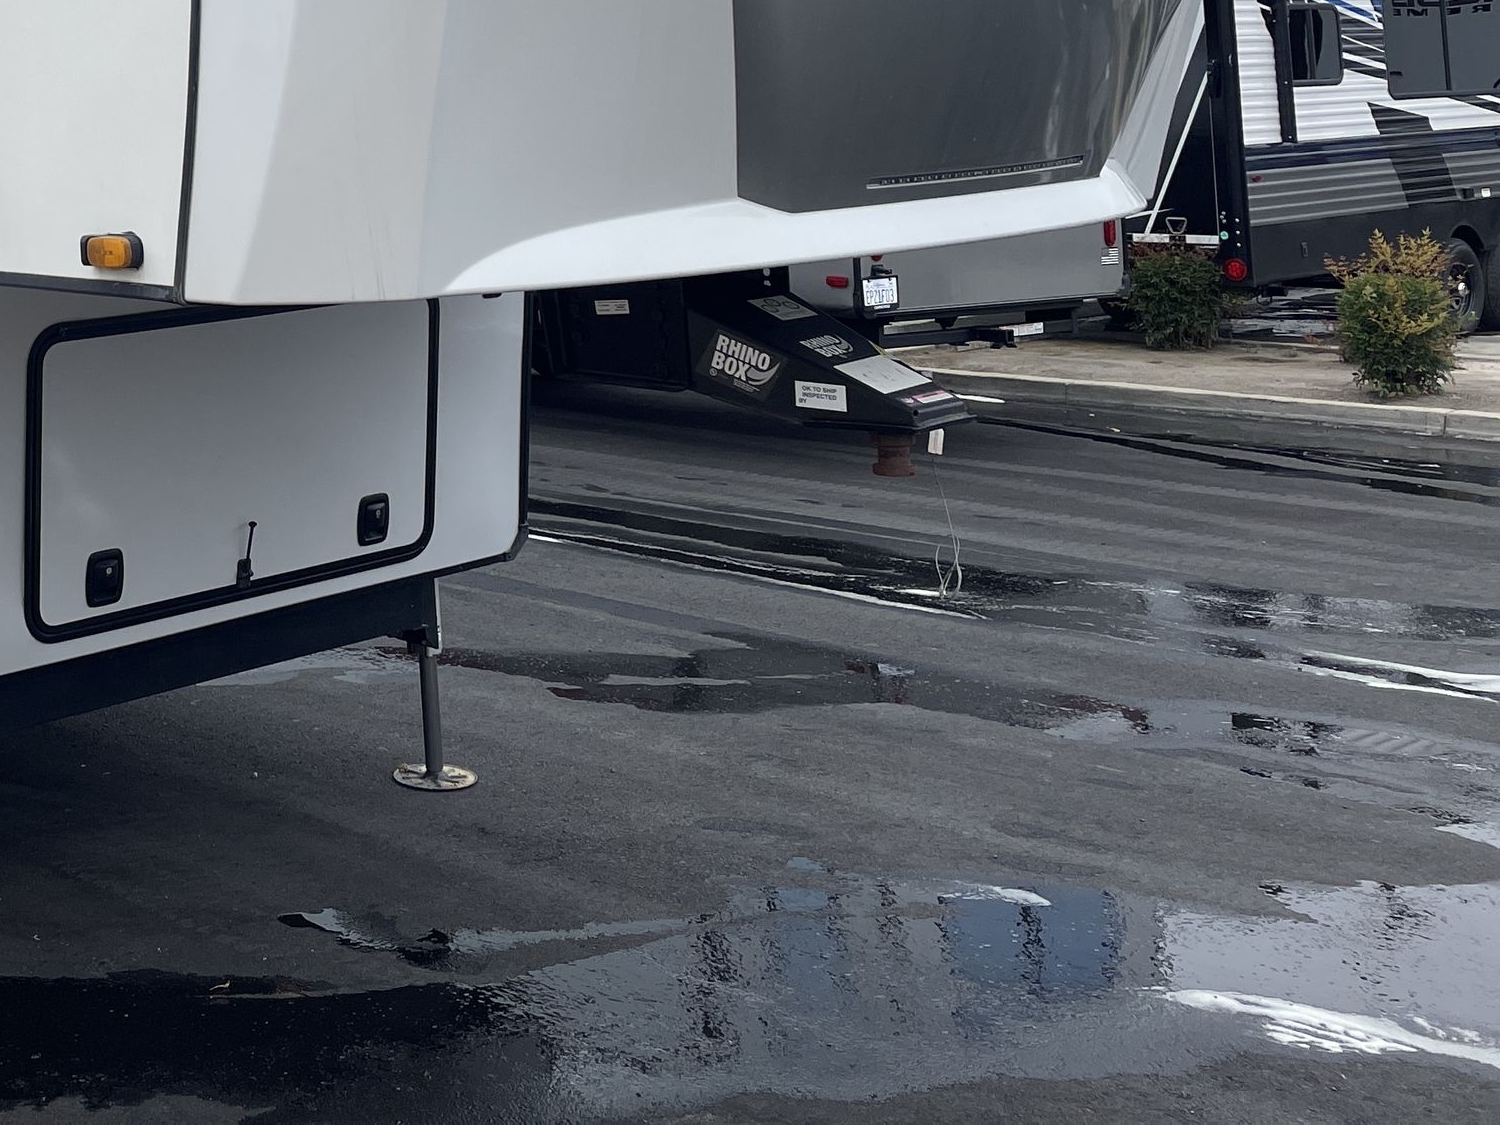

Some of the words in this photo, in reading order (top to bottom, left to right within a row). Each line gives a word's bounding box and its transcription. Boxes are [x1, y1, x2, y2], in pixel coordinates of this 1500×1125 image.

[711, 350, 751, 381] BOX
[715, 334, 771, 371] RHINO
[802, 392, 837, 400] INSPECTED
